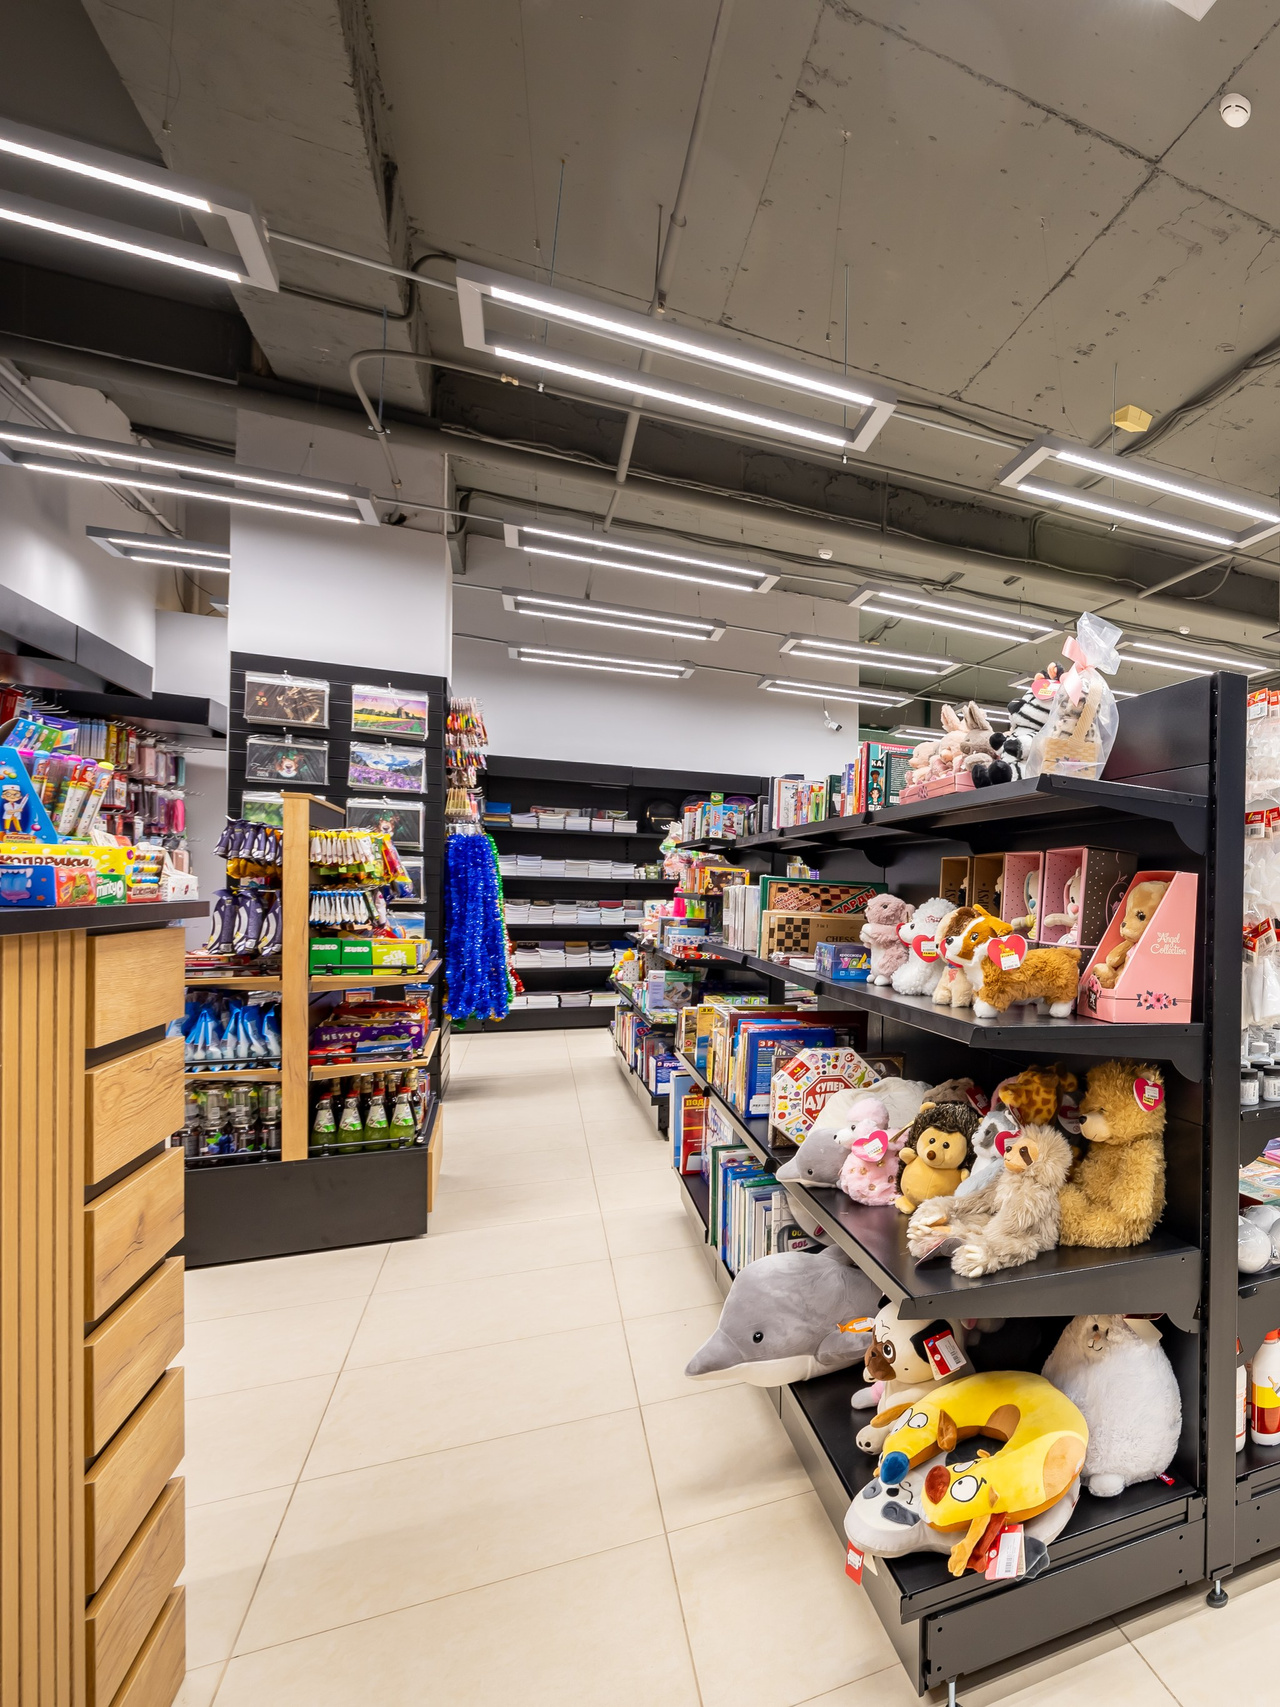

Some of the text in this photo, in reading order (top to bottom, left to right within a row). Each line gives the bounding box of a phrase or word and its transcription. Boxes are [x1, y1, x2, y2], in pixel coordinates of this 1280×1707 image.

[832, 888, 877, 914] НАРДЫ
[1157, 932, 1180, 948] Angel
[1150, 943, 1187, 955] Collection
[845, 1053, 855, 1062] 6+
[815, 1081, 845, 1093] СУПЕР
